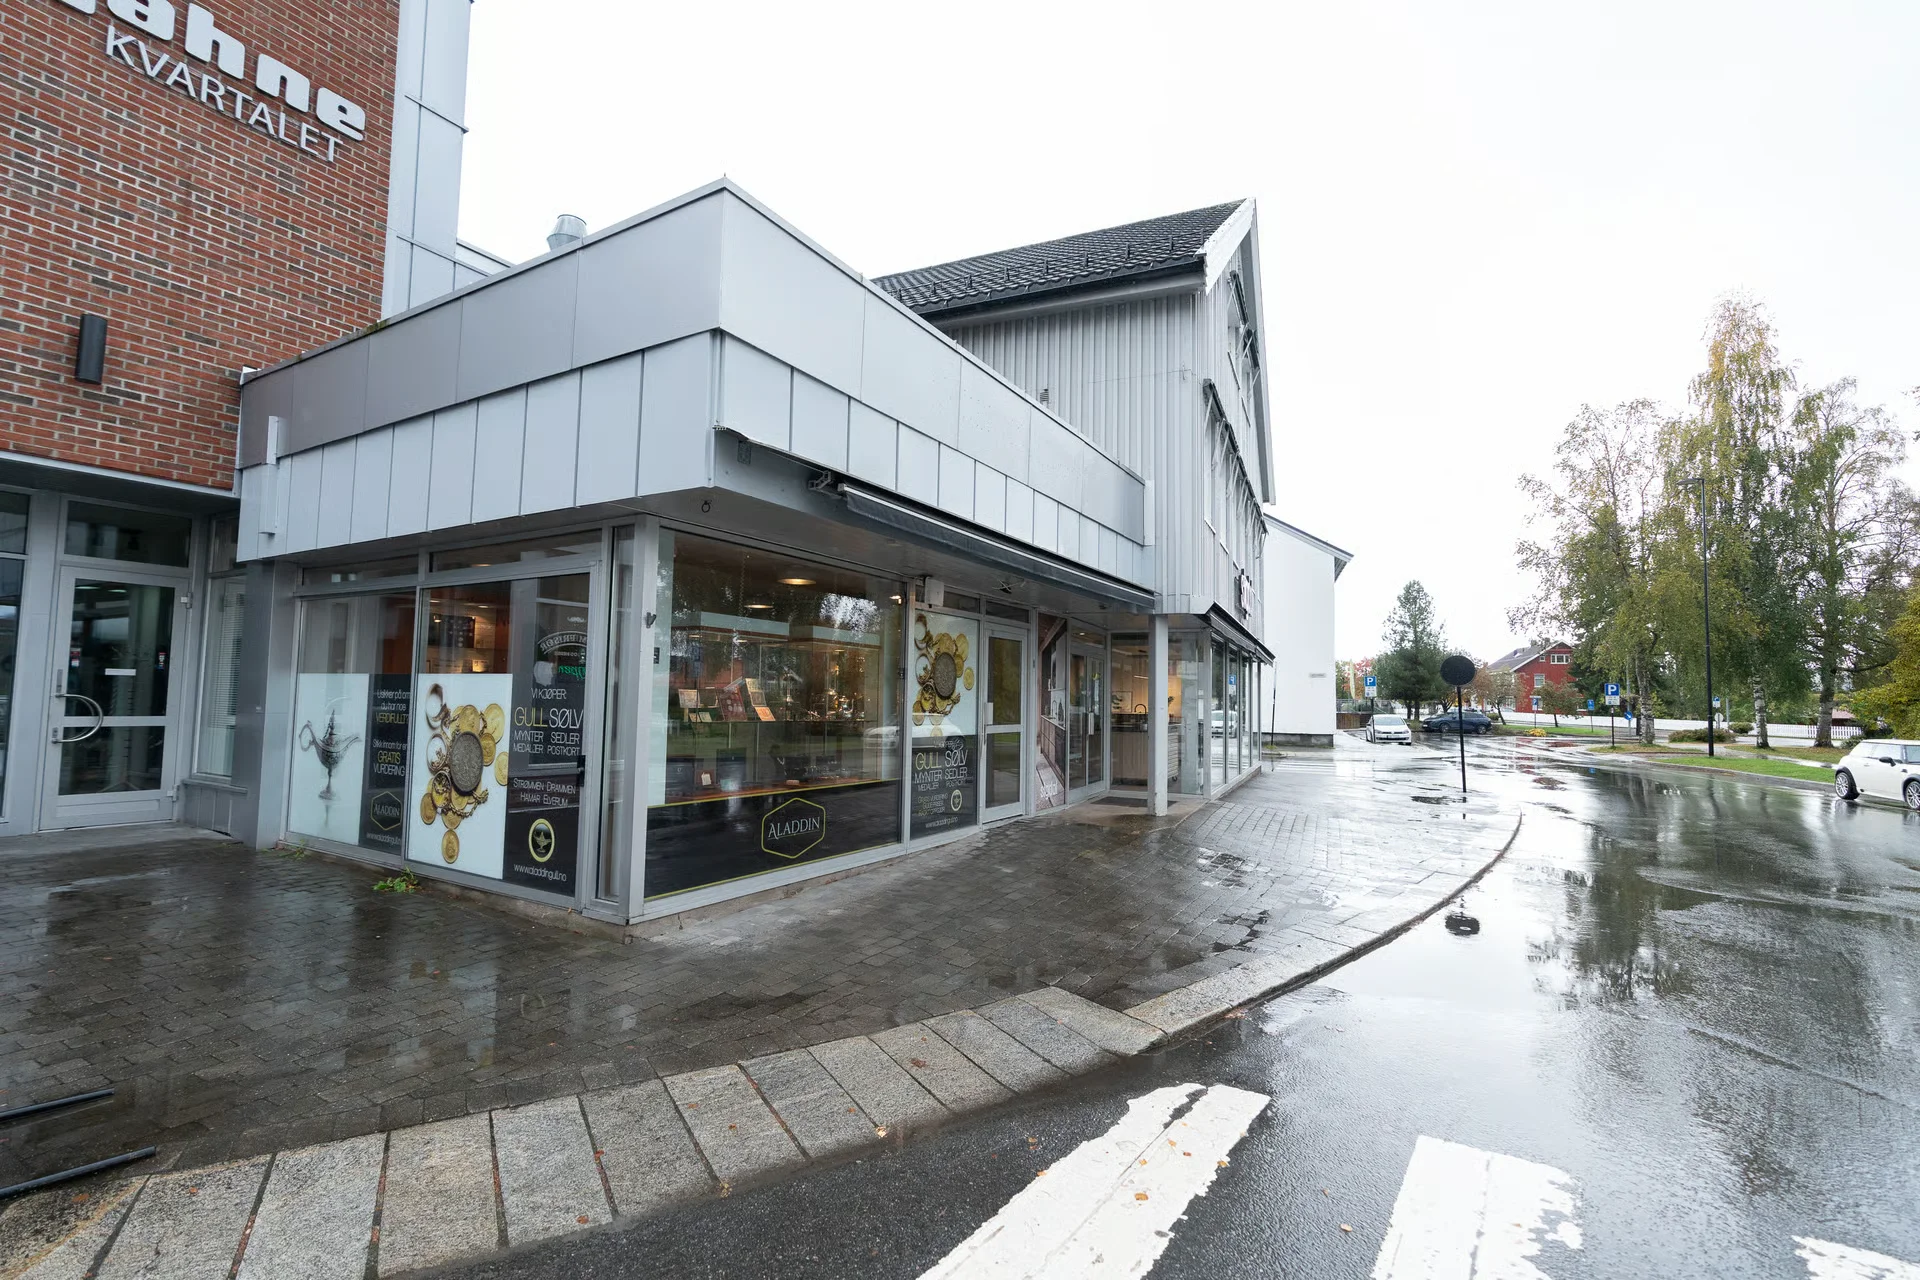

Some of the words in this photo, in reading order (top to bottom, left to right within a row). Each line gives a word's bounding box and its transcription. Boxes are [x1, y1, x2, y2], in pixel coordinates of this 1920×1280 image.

[57, 0, 367, 142] ahne
[104, 25, 344, 163] KVARTALET
[1608, 684, 1617, 695] P
[514, 706, 548, 727] GULL
[548, 708, 584, 729] SØLV
[513, 730, 544, 743] MYNTER
[550, 731, 580, 745] SEDLER
[377, 750, 401, 765] GRATIS
[547, 745, 580, 757] POSTKORT
[915, 752, 942, 770] GULL
[944, 749, 968, 767] SØLV
[373, 763, 406, 777] VURDERING
[914, 769, 943, 784] MYNTER
[944, 766, 968, 780] SEDLER
[373, 803, 401, 818] ALADDIN
[767, 816, 821, 840] ALADDIN
